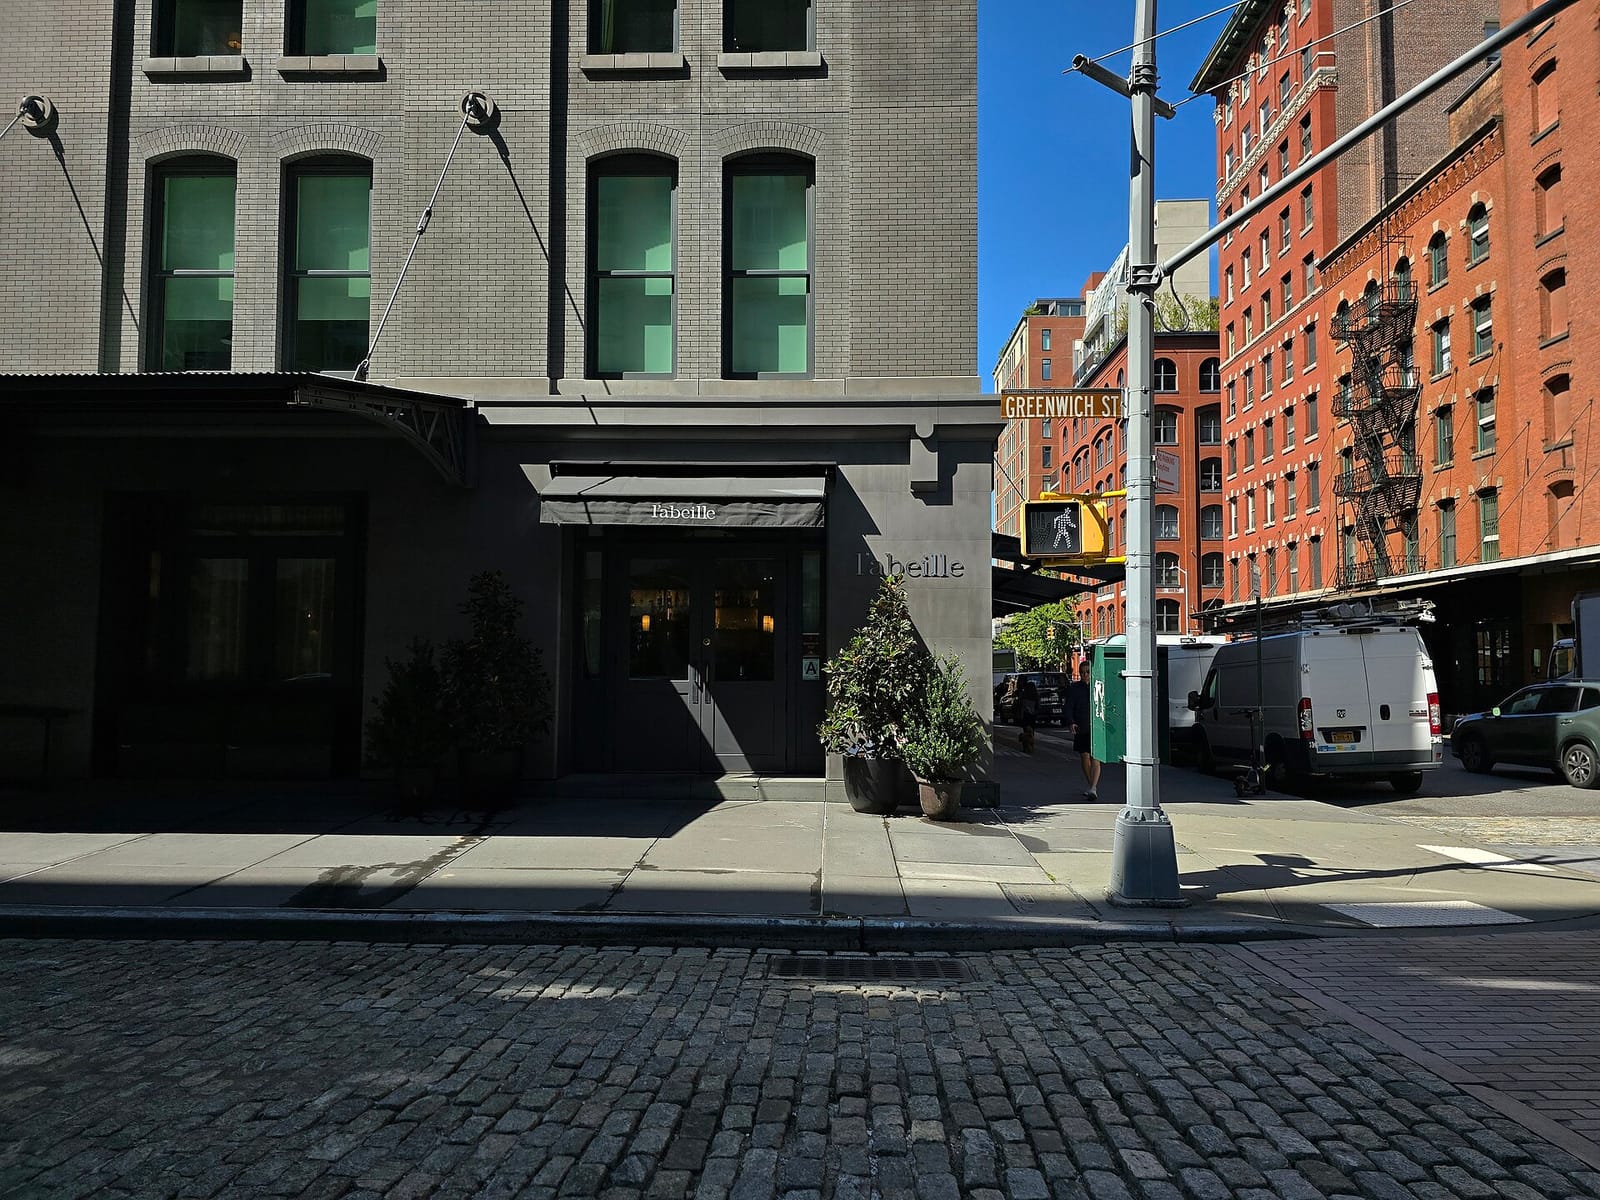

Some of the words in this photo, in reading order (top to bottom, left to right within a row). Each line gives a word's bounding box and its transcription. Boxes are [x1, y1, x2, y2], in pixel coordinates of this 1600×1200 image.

[1005, 396, 1094, 418] GREENWICH
[1101, 395, 1119, 417] ST
[651, 504, 716, 520] l'abeille
[856, 553, 965, 578] l'abeille
[805, 661, 817, 675] A
